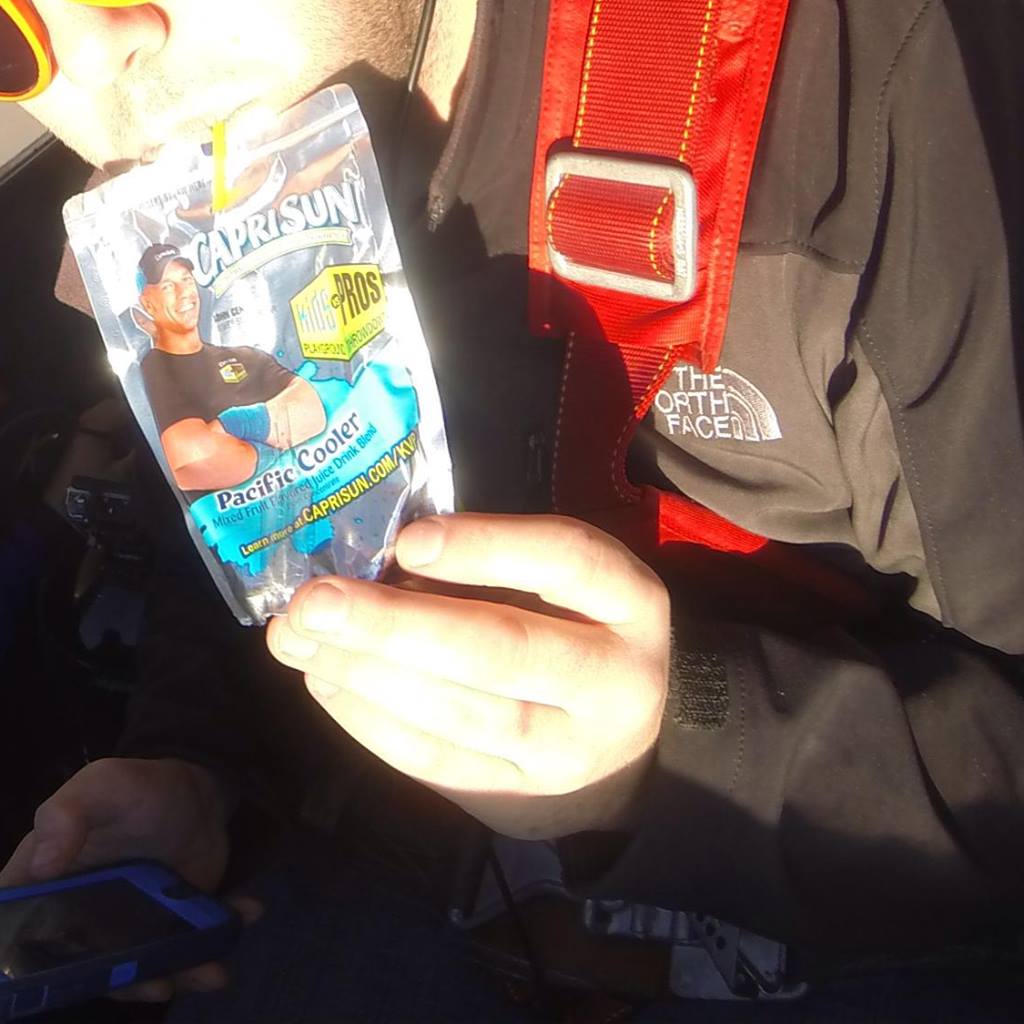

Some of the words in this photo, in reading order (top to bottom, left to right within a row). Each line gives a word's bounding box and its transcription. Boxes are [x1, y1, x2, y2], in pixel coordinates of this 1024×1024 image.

[333, 271, 381, 326] PROS
[672, 366, 726, 391] THE
[654, 389, 730, 415] ORTH
[665, 414, 731, 440] FACE
[212, 510, 244, 528] Mixed
[246, 499, 269, 517] Fruit
[311, 465, 335, 489] Juice
[332, 445, 360, 470] Drink
[356, 422, 378, 449] Blend
[216, 468, 294, 510] Pacific
[297, 412, 359, 471] Cooler
[240, 536, 270, 557] Learn
[270, 525, 293, 543] more
